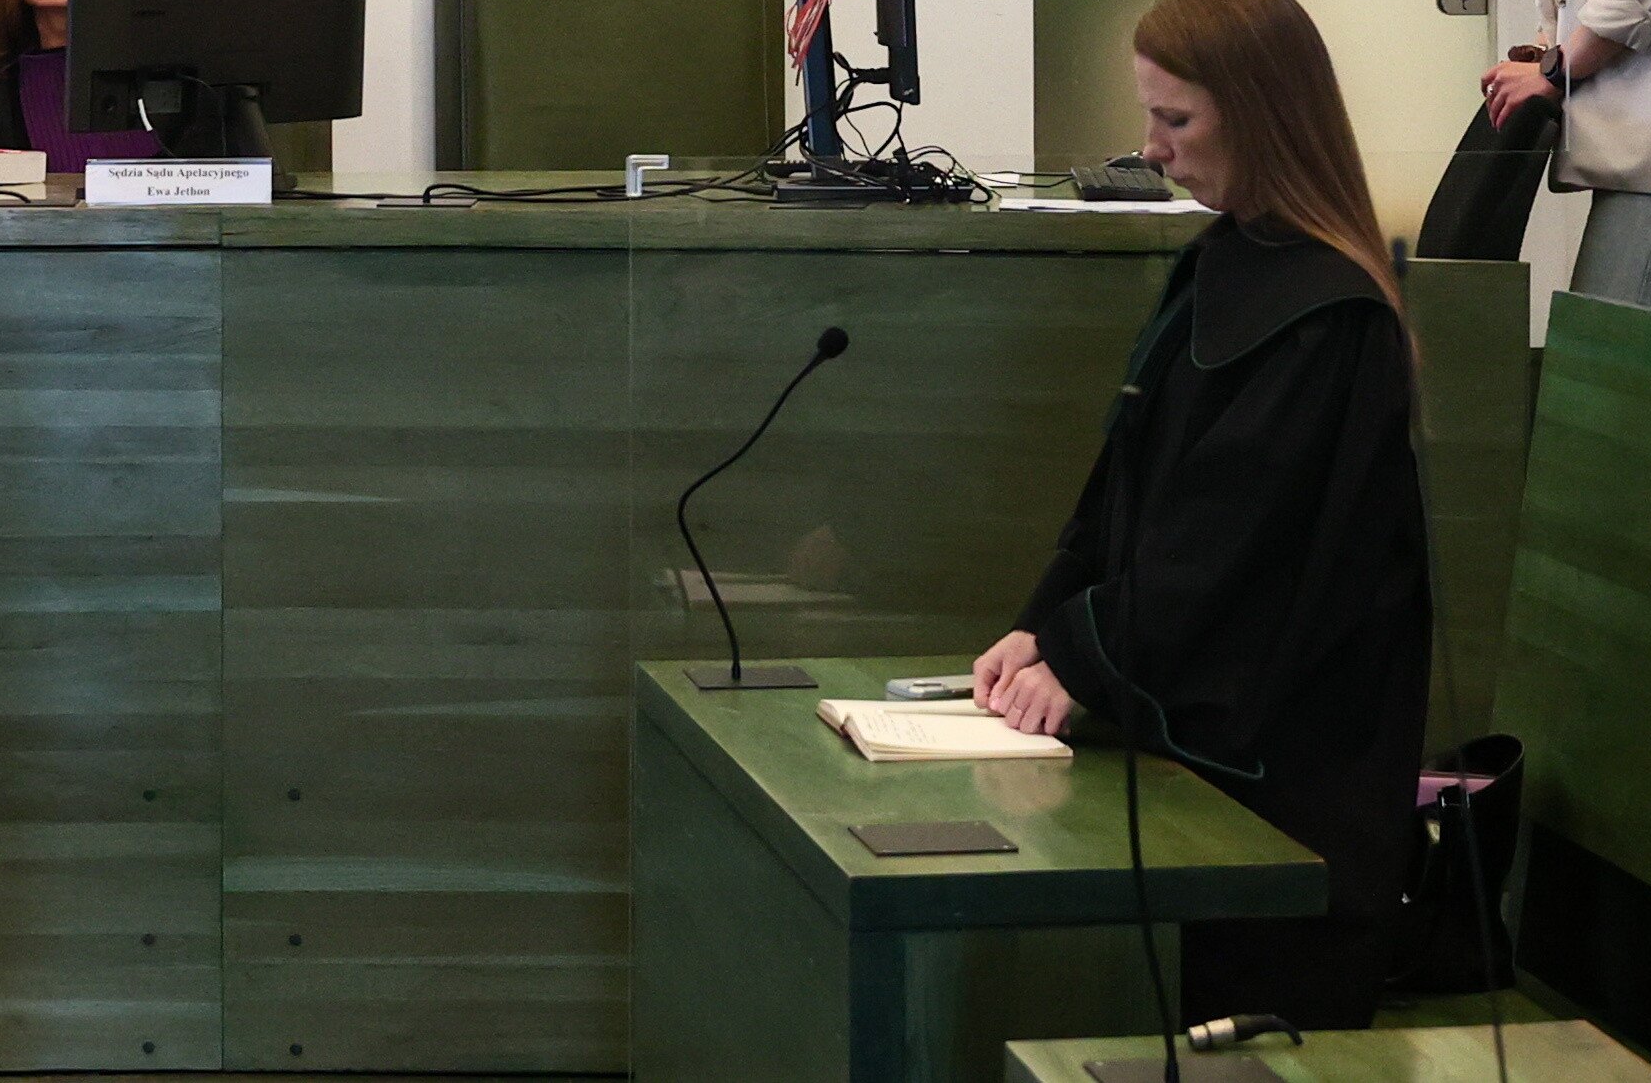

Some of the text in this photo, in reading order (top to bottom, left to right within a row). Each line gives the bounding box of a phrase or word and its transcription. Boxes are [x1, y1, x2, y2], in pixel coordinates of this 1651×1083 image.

[108, 167, 249, 179] Sędzia Sądu Apelacyjnego
[147, 186, 171, 196] Ewa
